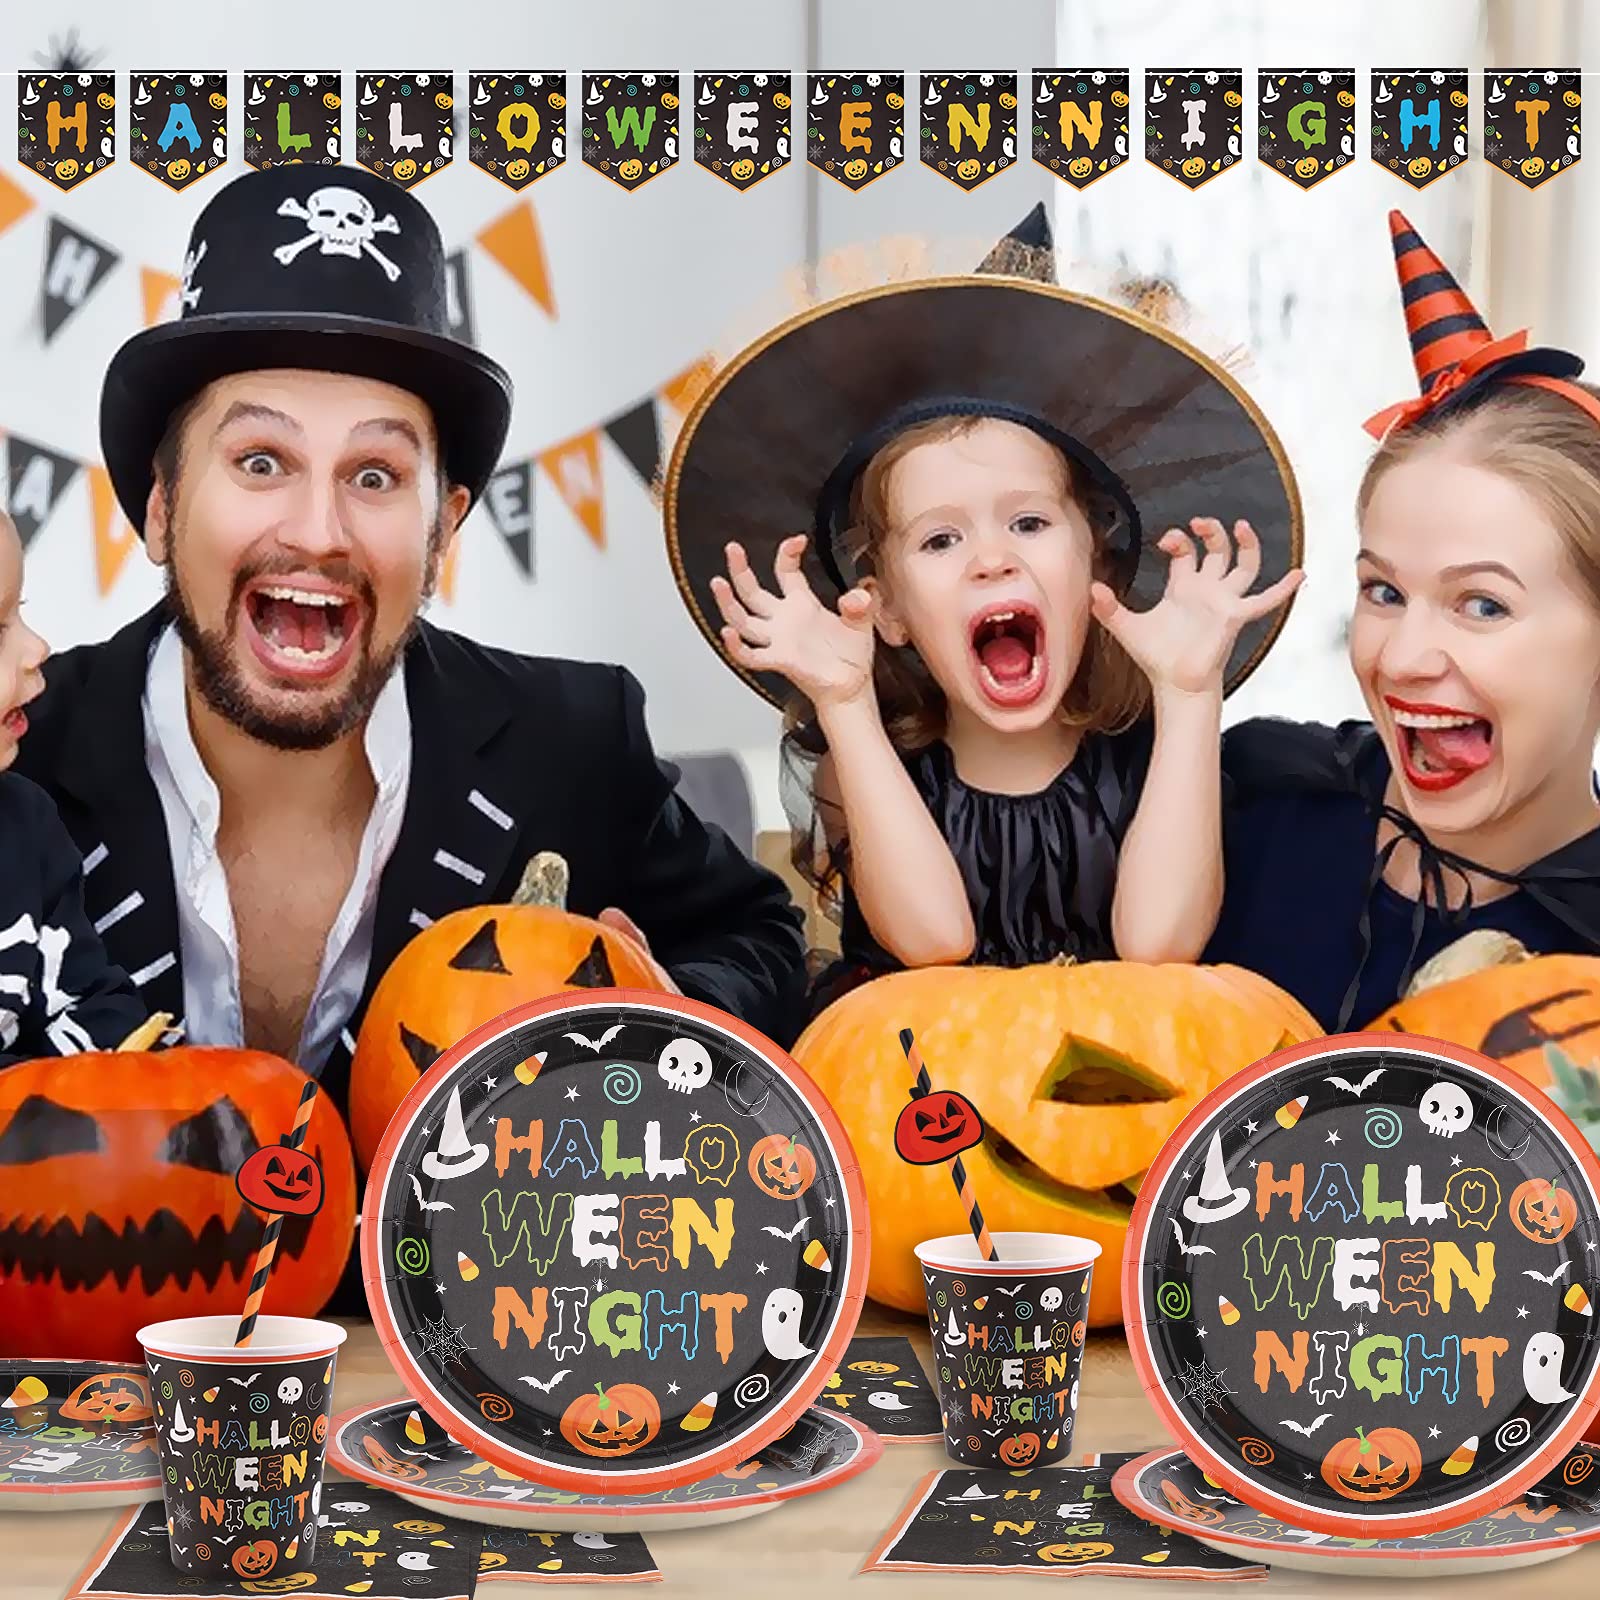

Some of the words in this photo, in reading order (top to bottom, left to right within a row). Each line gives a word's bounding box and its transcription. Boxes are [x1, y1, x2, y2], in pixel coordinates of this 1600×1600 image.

[493, 1117, 741, 1187] HALLO
[1254, 1161, 1501, 1231] HALLO
[480, 1188, 737, 1277] WEEN
[1241, 1232, 1497, 1321] WEEN
[491, 1285, 749, 1365] NIGHT
[968, 1320, 1070, 1354] HALLO
[964, 1351, 1068, 1393] WEEN
[1252, 1329, 1510, 1409] NIGHT
[195, 1414, 312, 1451] HALLO
[970, 1388, 1069, 1426] NIGHT
[191, 1448, 309, 1495] WEEN
[199, 1490, 310, 1532] NIGHT
